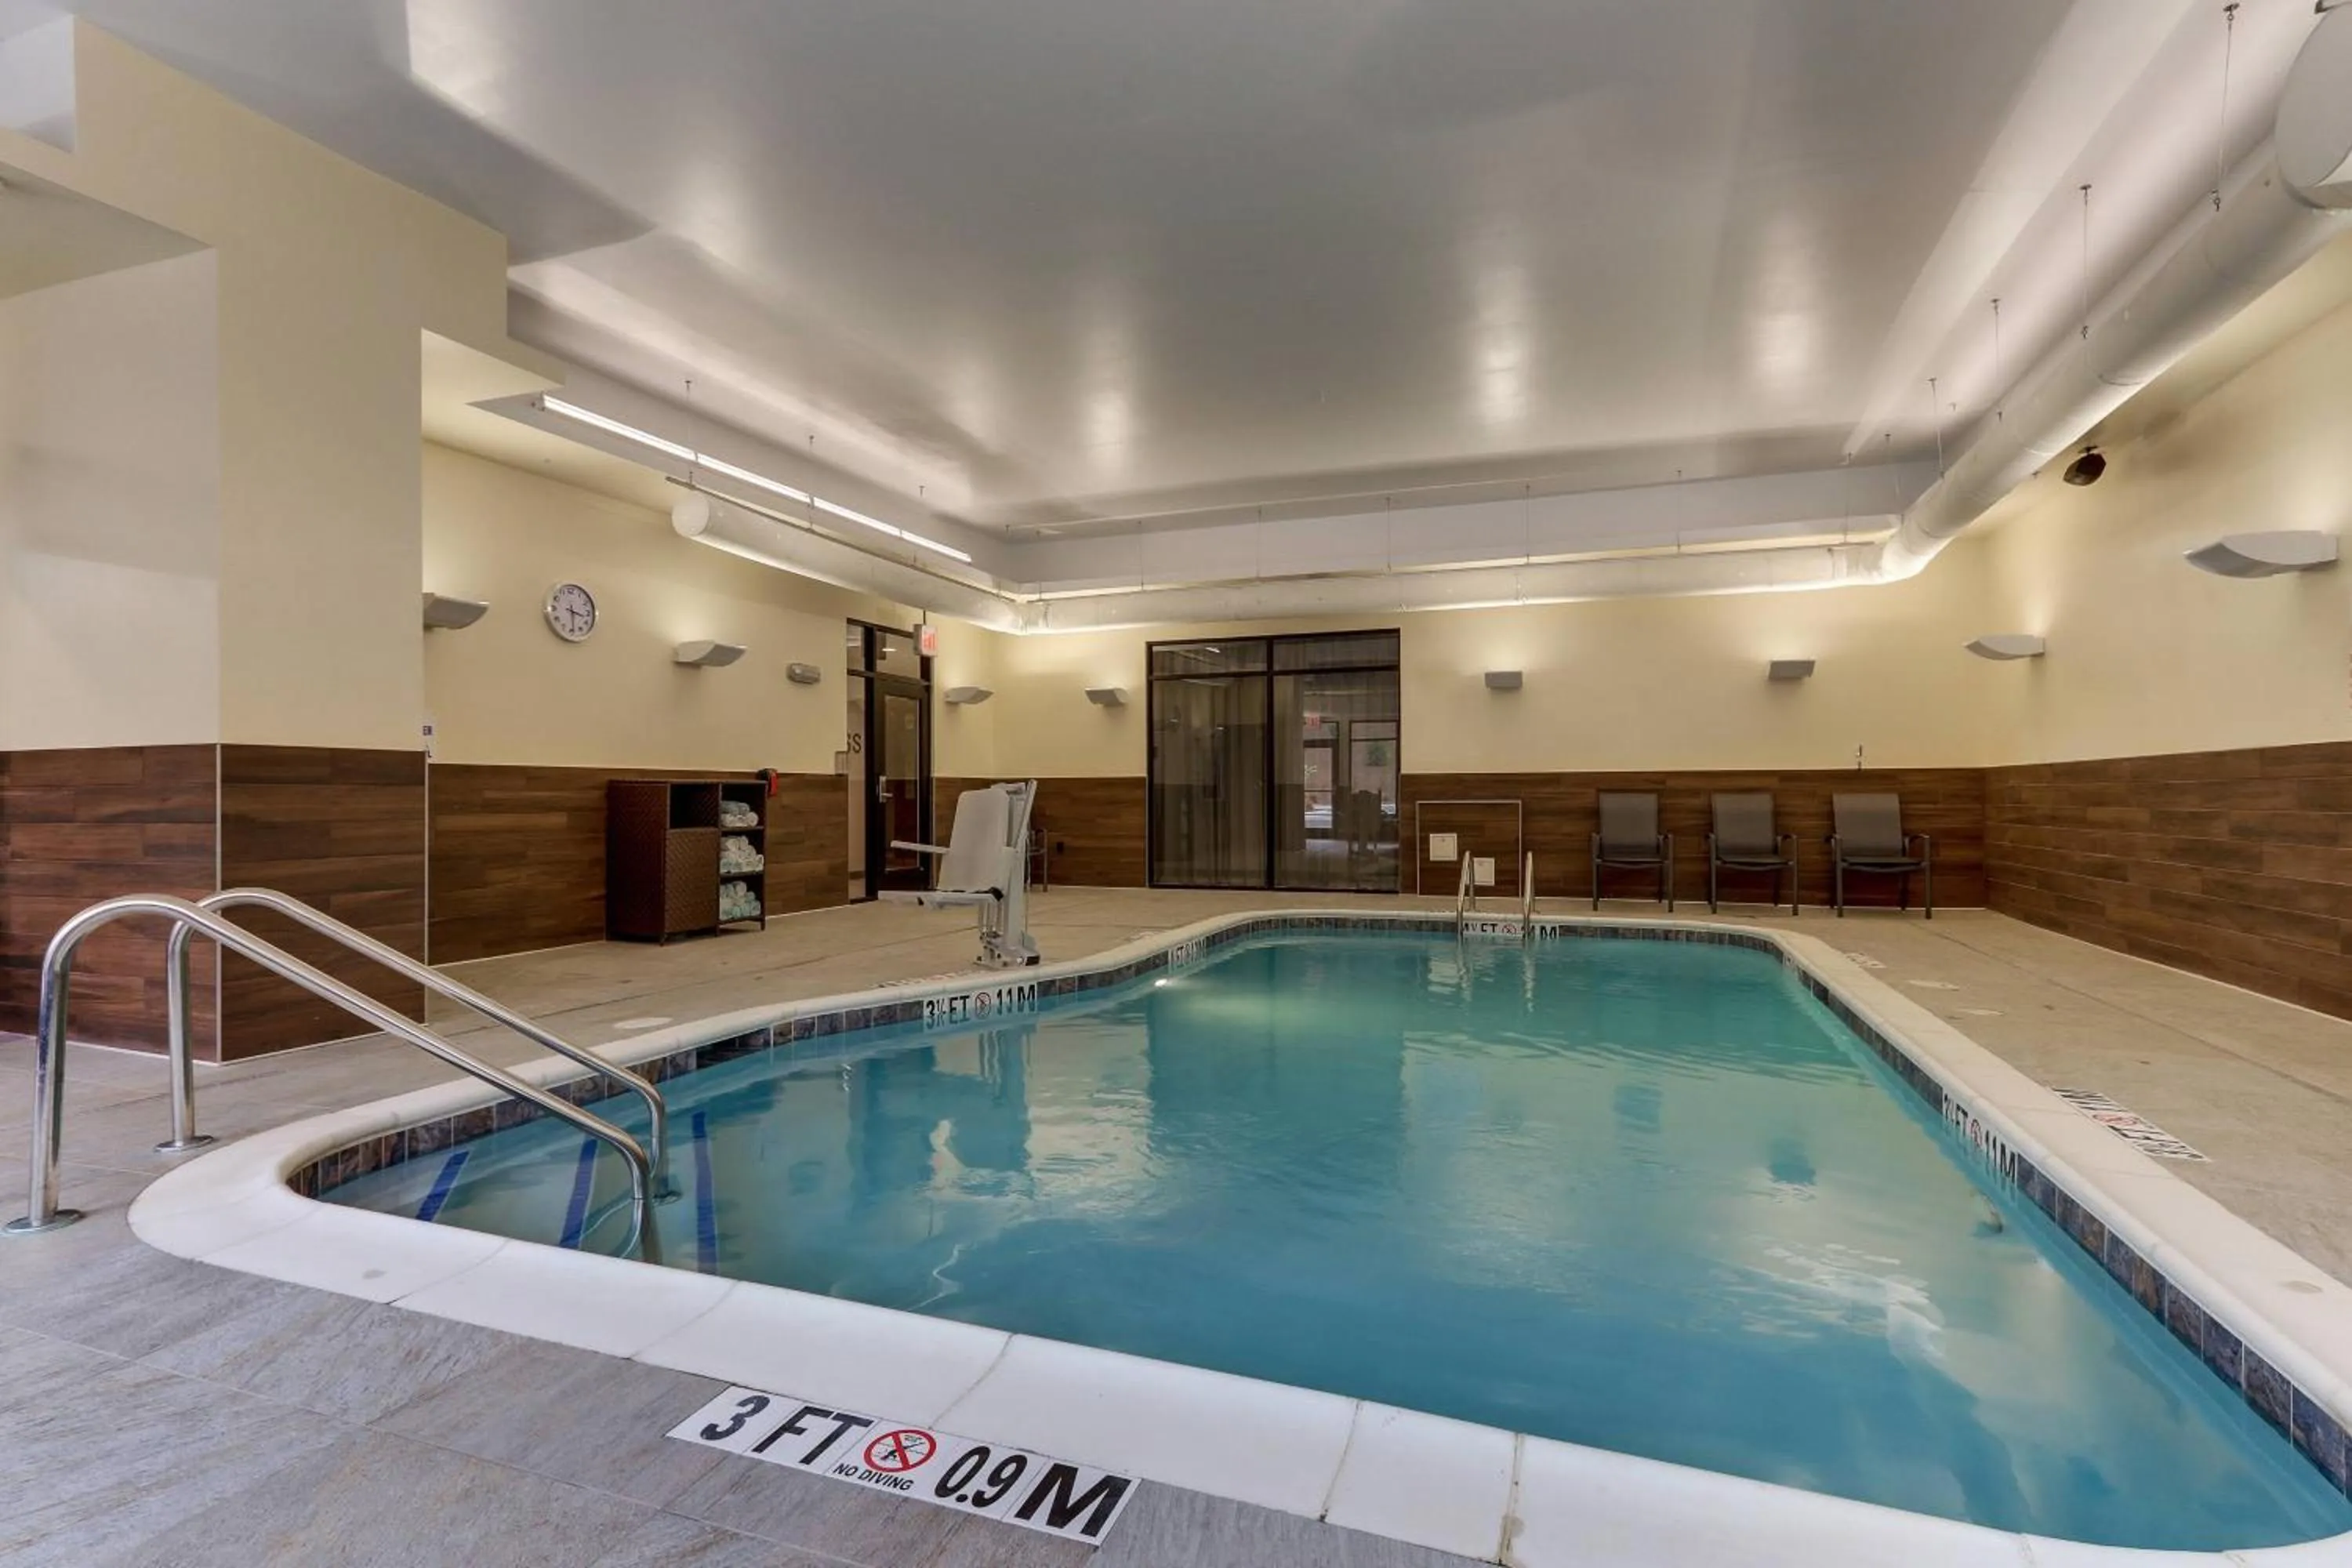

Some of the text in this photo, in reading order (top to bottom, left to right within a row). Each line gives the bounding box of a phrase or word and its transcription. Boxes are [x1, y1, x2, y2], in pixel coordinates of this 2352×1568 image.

[700, 1395, 1131, 1537] 3 FT 0.9 M
[833, 1463, 914, 1490] NO DIVING
